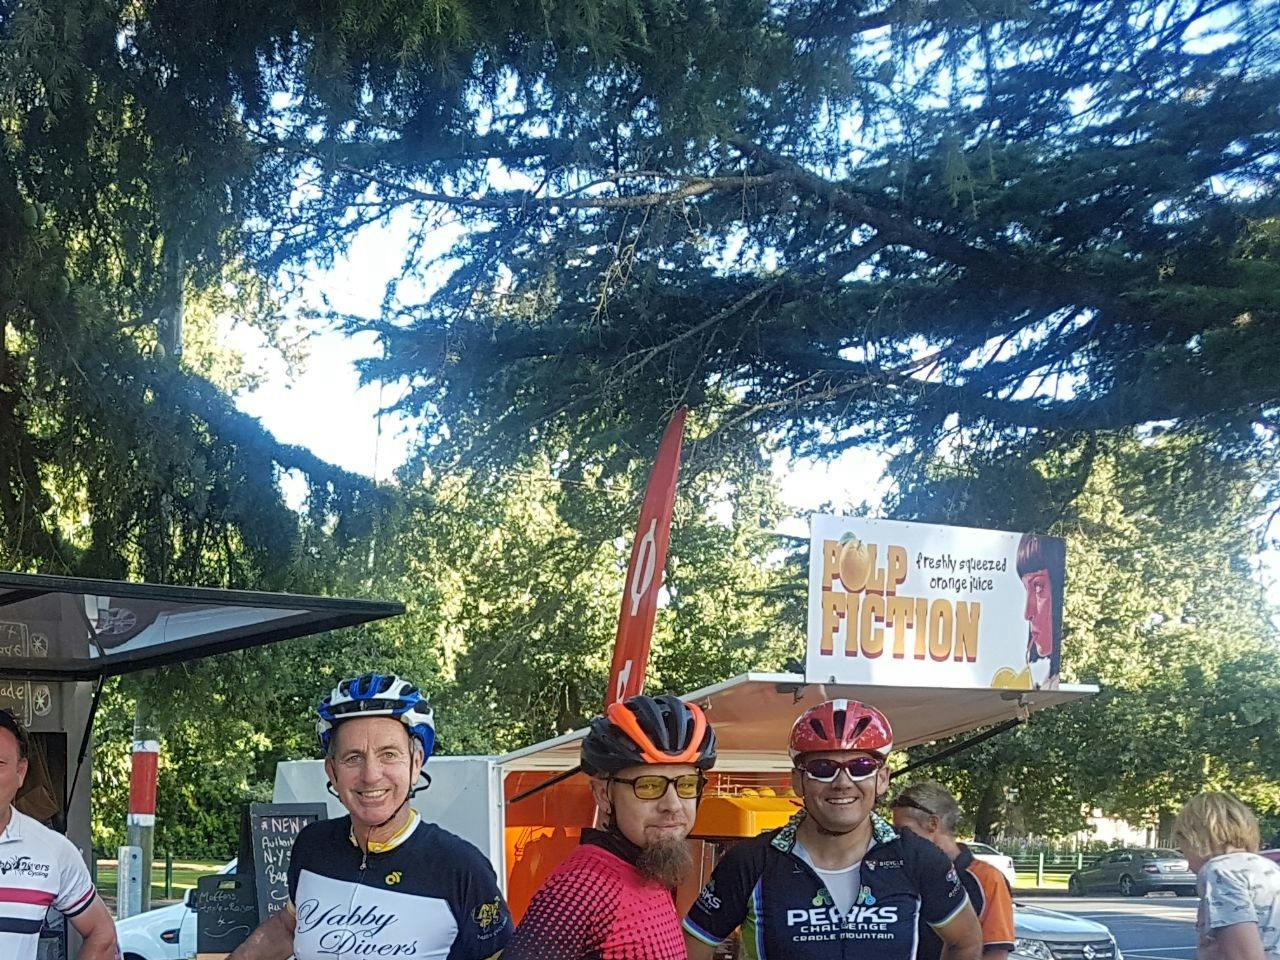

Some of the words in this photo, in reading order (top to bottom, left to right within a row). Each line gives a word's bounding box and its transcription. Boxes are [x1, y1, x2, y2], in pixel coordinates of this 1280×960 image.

[915, 551, 957, 573] freshly
[958, 554, 1008, 574] squeezed
[929, 575, 967, 594] orange
[968, 574, 994, 593] juice
[820, 596, 982, 663] FICTION
[271, 817, 299, 834] NEW
[296, 898, 400, 936] Yabby
[316, 928, 418, 956] Divers
[792, 933, 837, 943] CRADLE
